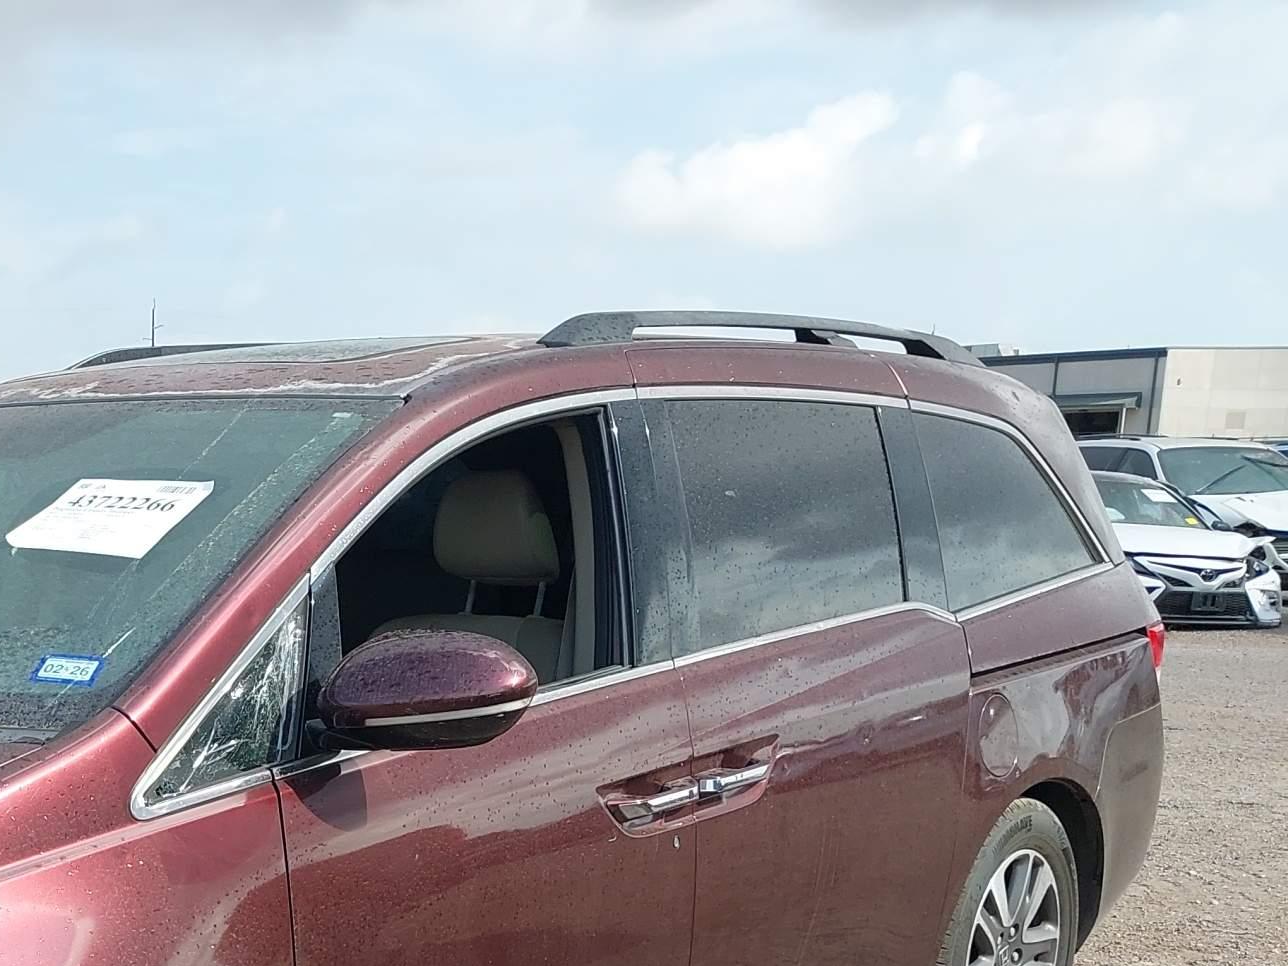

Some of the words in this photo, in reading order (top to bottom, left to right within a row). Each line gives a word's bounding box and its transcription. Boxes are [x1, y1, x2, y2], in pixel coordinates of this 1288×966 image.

[67, 494, 181, 512] 43722266
[44, 664, 64, 673] 02
[70, 666, 90, 676] 26
